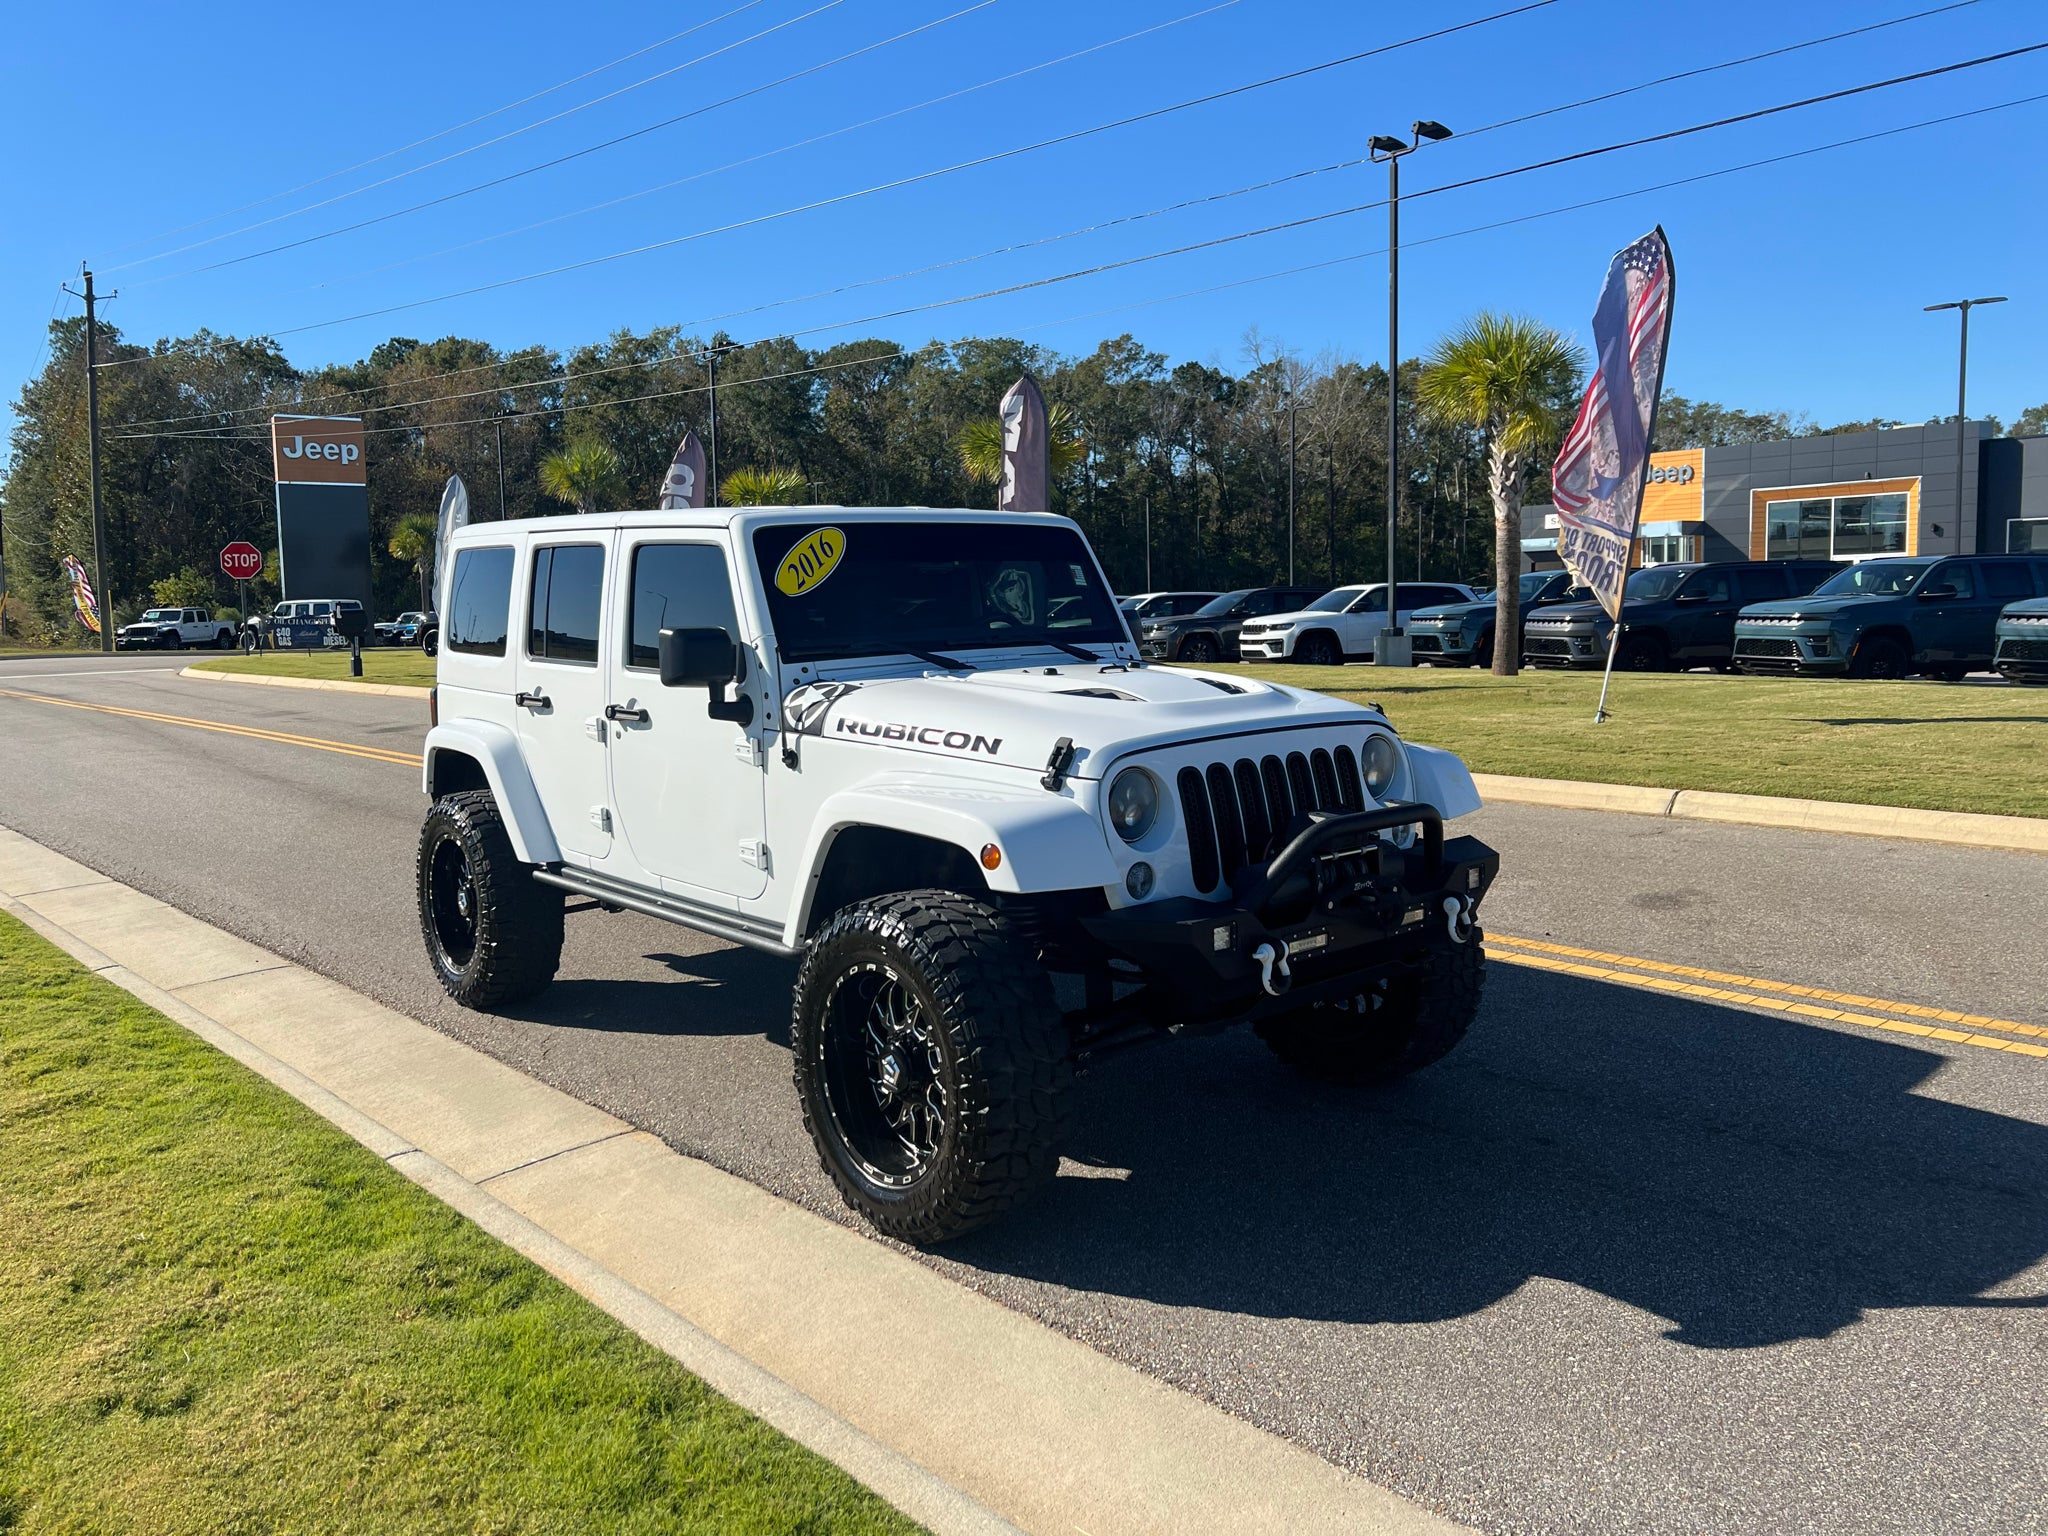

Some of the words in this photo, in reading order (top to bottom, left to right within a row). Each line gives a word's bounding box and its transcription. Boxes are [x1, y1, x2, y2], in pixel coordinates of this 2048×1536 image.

[282, 436, 359, 465] Jeep
[223, 554, 259, 568] STOP
[788, 532, 834, 590] 2016
[276, 627, 291, 637] $40
[278, 636, 292, 646] GAS
[323, 636, 347, 646] DIESEL
[836, 717, 1003, 755] RUBICON
